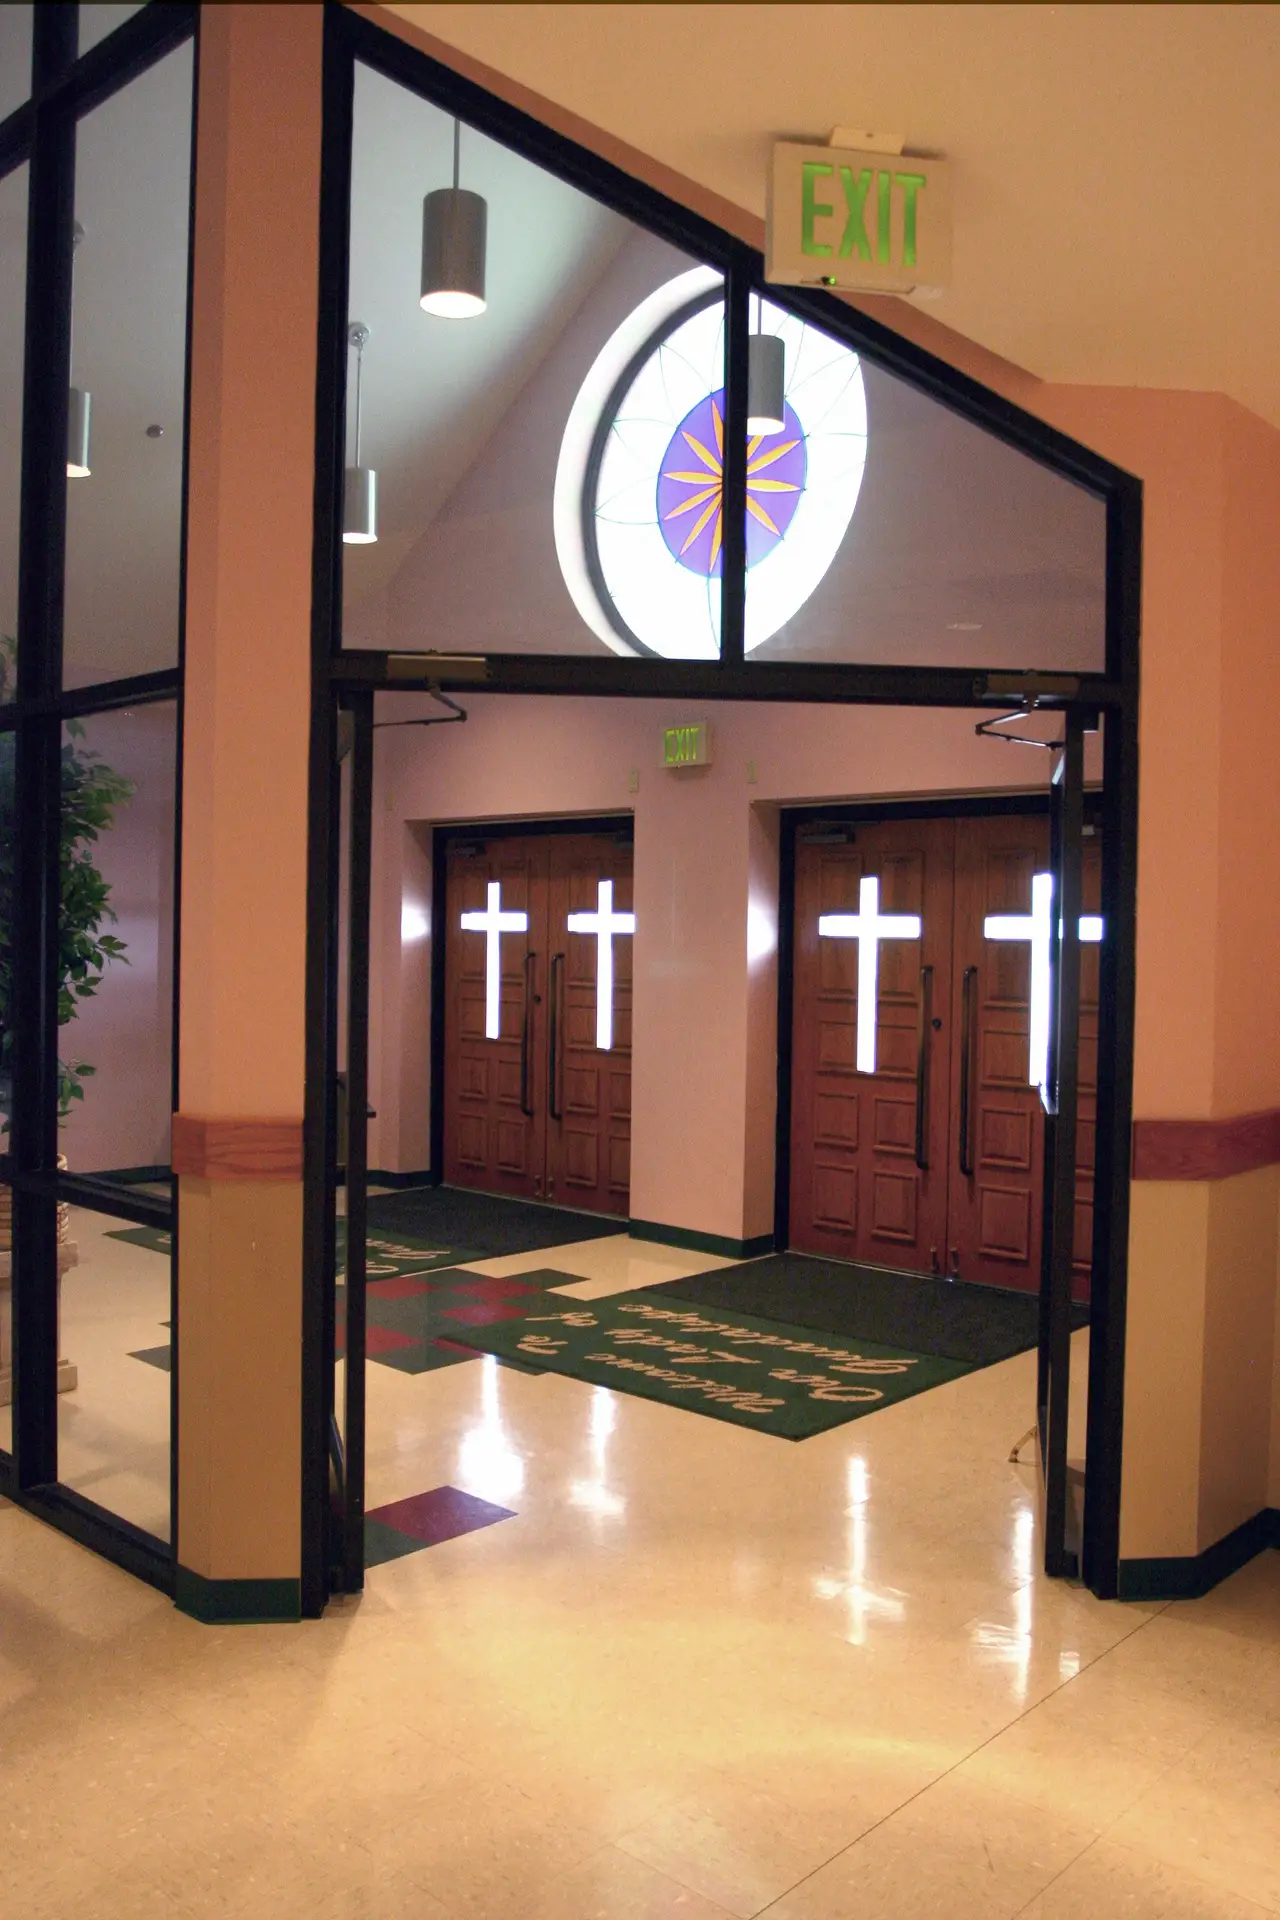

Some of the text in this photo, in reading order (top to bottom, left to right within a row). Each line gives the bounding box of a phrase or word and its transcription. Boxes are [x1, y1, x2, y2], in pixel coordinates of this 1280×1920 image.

[802, 161, 926, 267] EXIT
[665, 728, 699, 763] EXIT
[604, 1329, 762, 1364] Lady
[618, 1304, 919, 1375] Guadalupe
[516, 1335, 785, 1413] Welcome To
[768, 1368, 884, 1402] Our
